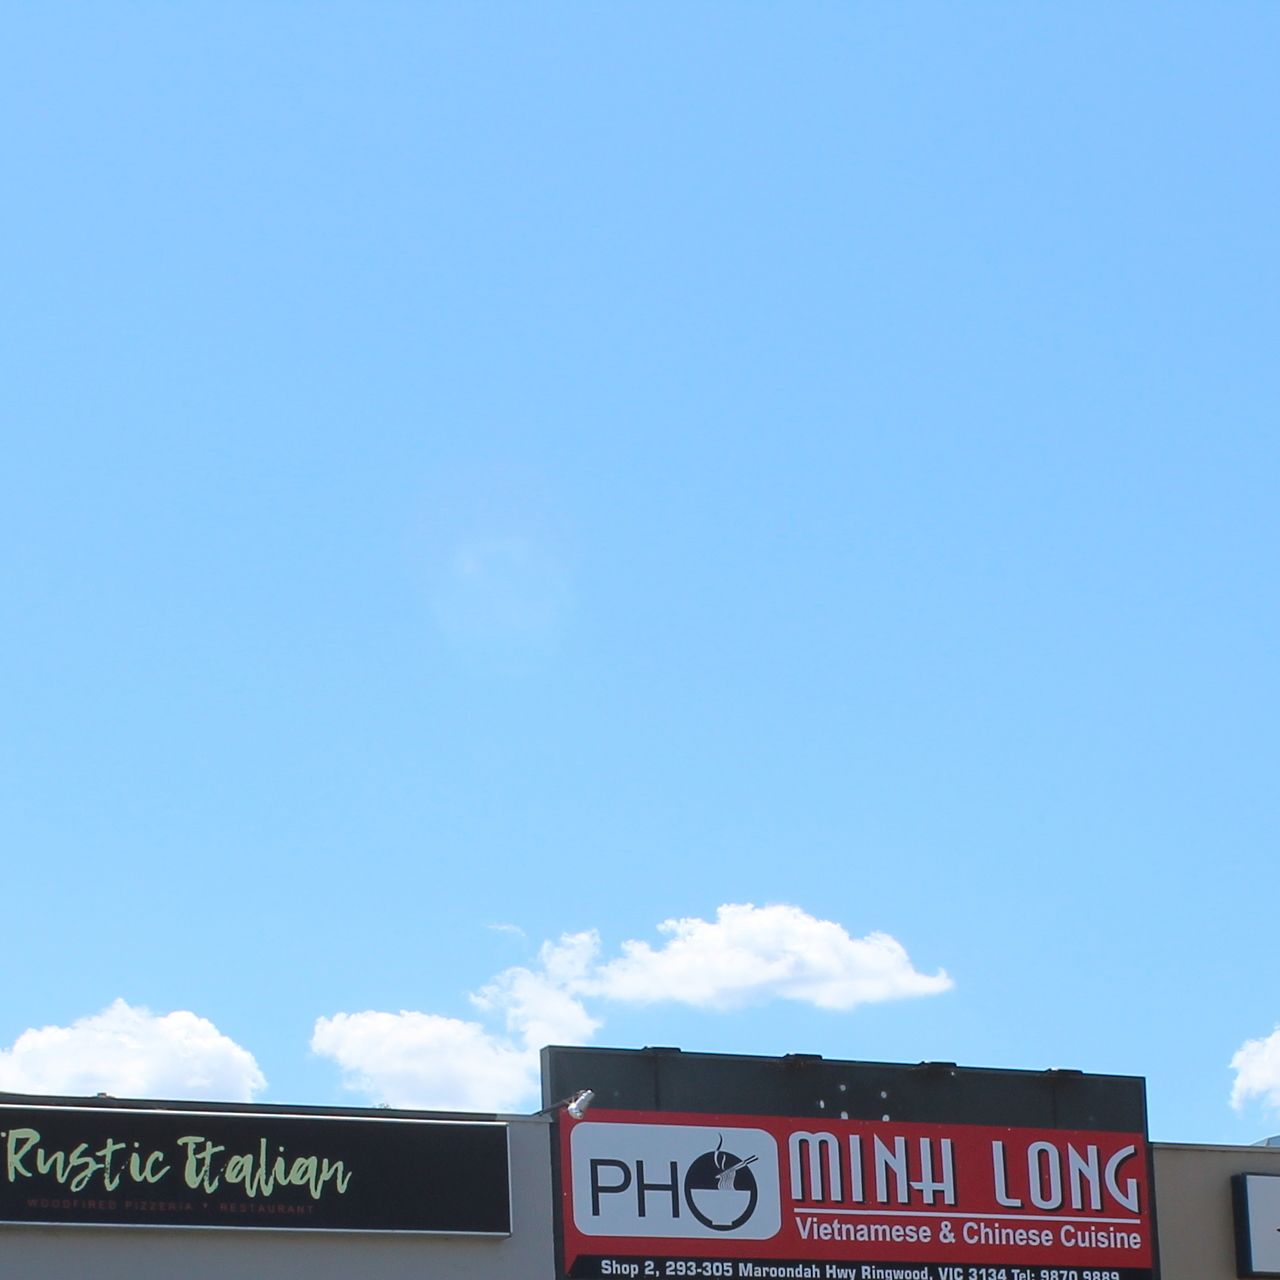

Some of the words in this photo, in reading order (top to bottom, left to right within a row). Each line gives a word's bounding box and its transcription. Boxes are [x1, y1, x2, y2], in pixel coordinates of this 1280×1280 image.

[1, 1128, 171, 1192] Rustic
[177, 1135, 352, 1199] Italian
[589, 1150, 758, 1231] PHO
[788, 1130, 955, 1205] MINH
[991, 1140, 1140, 1213] LONG
[27, 1200, 118, 1210] WOODFIRED
[125, 1200, 194, 1211] PIZZERIA
[220, 1203, 315, 1215] RESTAURANT
[794, 1216, 932, 1243] Vietnamese
[938, 1221, 956, 1244] &
[962, 1222, 1054, 1247] Chinese
[1060, 1224, 1142, 1249] Cuisine
[601, 1259, 639, 1278] Shop
[644, 1260, 660, 1277] 2,
[665, 1261, 733, 1277] 293-305
[738, 1262, 820, 1279] Maroondah
